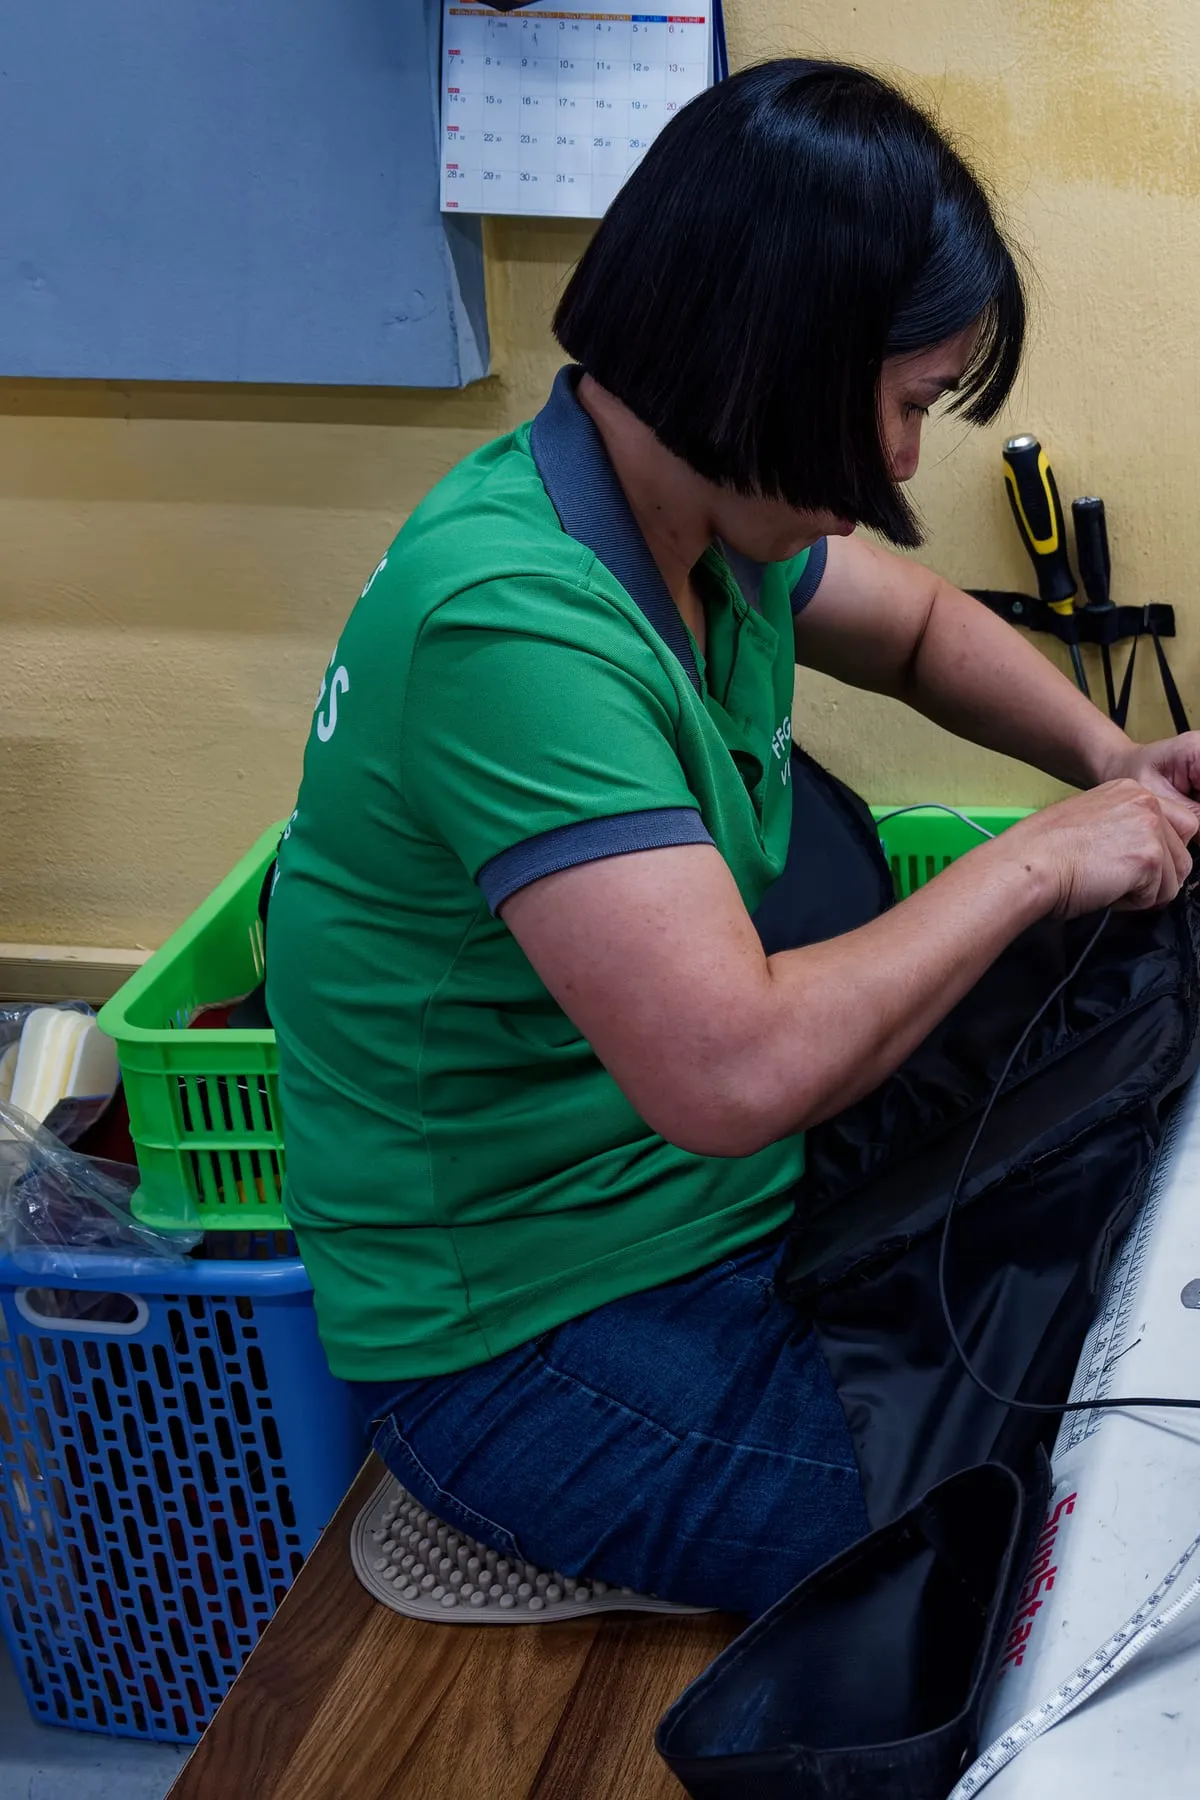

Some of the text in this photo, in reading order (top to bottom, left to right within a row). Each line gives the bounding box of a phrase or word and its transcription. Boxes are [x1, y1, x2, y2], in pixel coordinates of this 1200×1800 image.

[771, 716, 791, 759] FFG
[998, 1492, 1078, 1680] SunStar
[1002, 1736, 1016, 1750] 52
[980, 1755, 994, 1770] 51
[962, 1777, 975, 1791] 50
